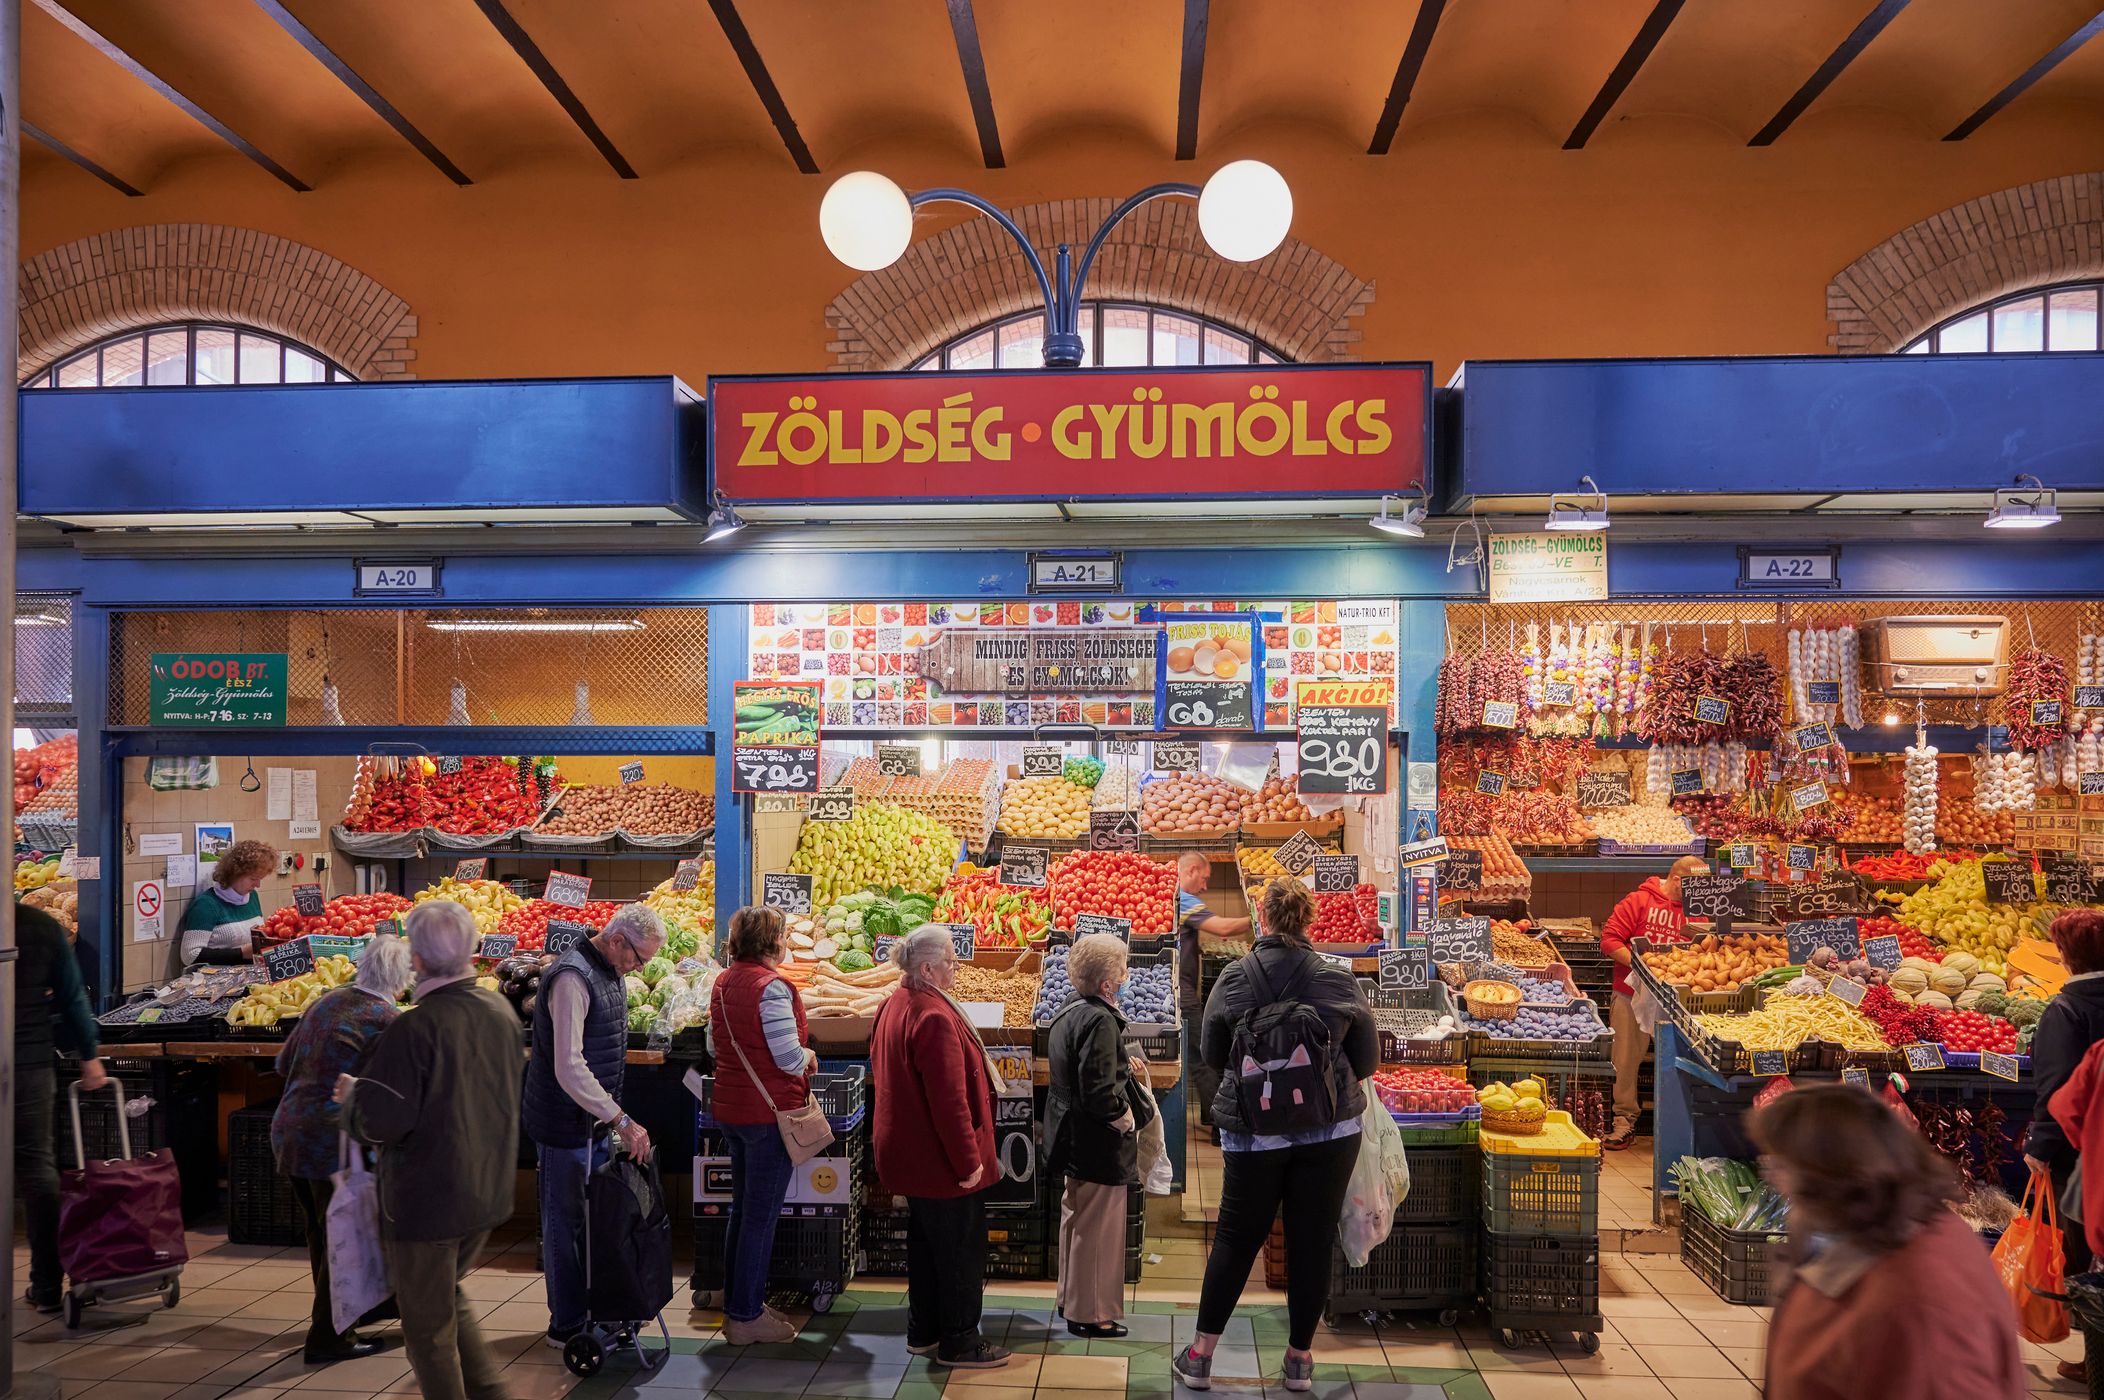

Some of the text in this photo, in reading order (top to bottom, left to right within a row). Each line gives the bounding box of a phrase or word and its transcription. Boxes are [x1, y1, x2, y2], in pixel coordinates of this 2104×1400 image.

[737, 385, 1393, 466] ZÖLDSÉG GYÜMÖLCS
[375, 568, 417, 587] A-20
[1053, 565, 1097, 582] A-21
[1766, 559, 1814, 577] A-22
[1338, 607, 1390, 618] NATUR-TRIO KFT
[1168, 622, 1252, 641] FRISS TOJÁS
[975, 635, 1157, 660] MINDIG FRISS ZÖLDSÉGE
[246, 663, 269, 679] BT.
[1008, 662, 1025, 686] ÉS
[737, 688, 816, 708] HEGYES ERŐS
[1301, 684, 1386, 704] AKCIÓ!
[163, 712, 193, 720] NYITVA:
[253, 712, 272, 720] 7-13
[738, 731, 815, 745] PAPRIKA
[1299, 737, 1381, 777] 980
[1405, 847, 1442, 861] NYITVA
[1319, 872, 1354, 891] 980
[551, 886, 579, 903] 680
[2001, 882, 2031, 902] 498
[1688, 895, 1730, 917] 598
[1798, 893, 1838, 914] 698
[275, 957, 305, 979] 580
[1381, 964, 1425, 986] 980
[993, 1056, 1031, 1081] MBA
[812, 1279, 840, 1295] A/21
